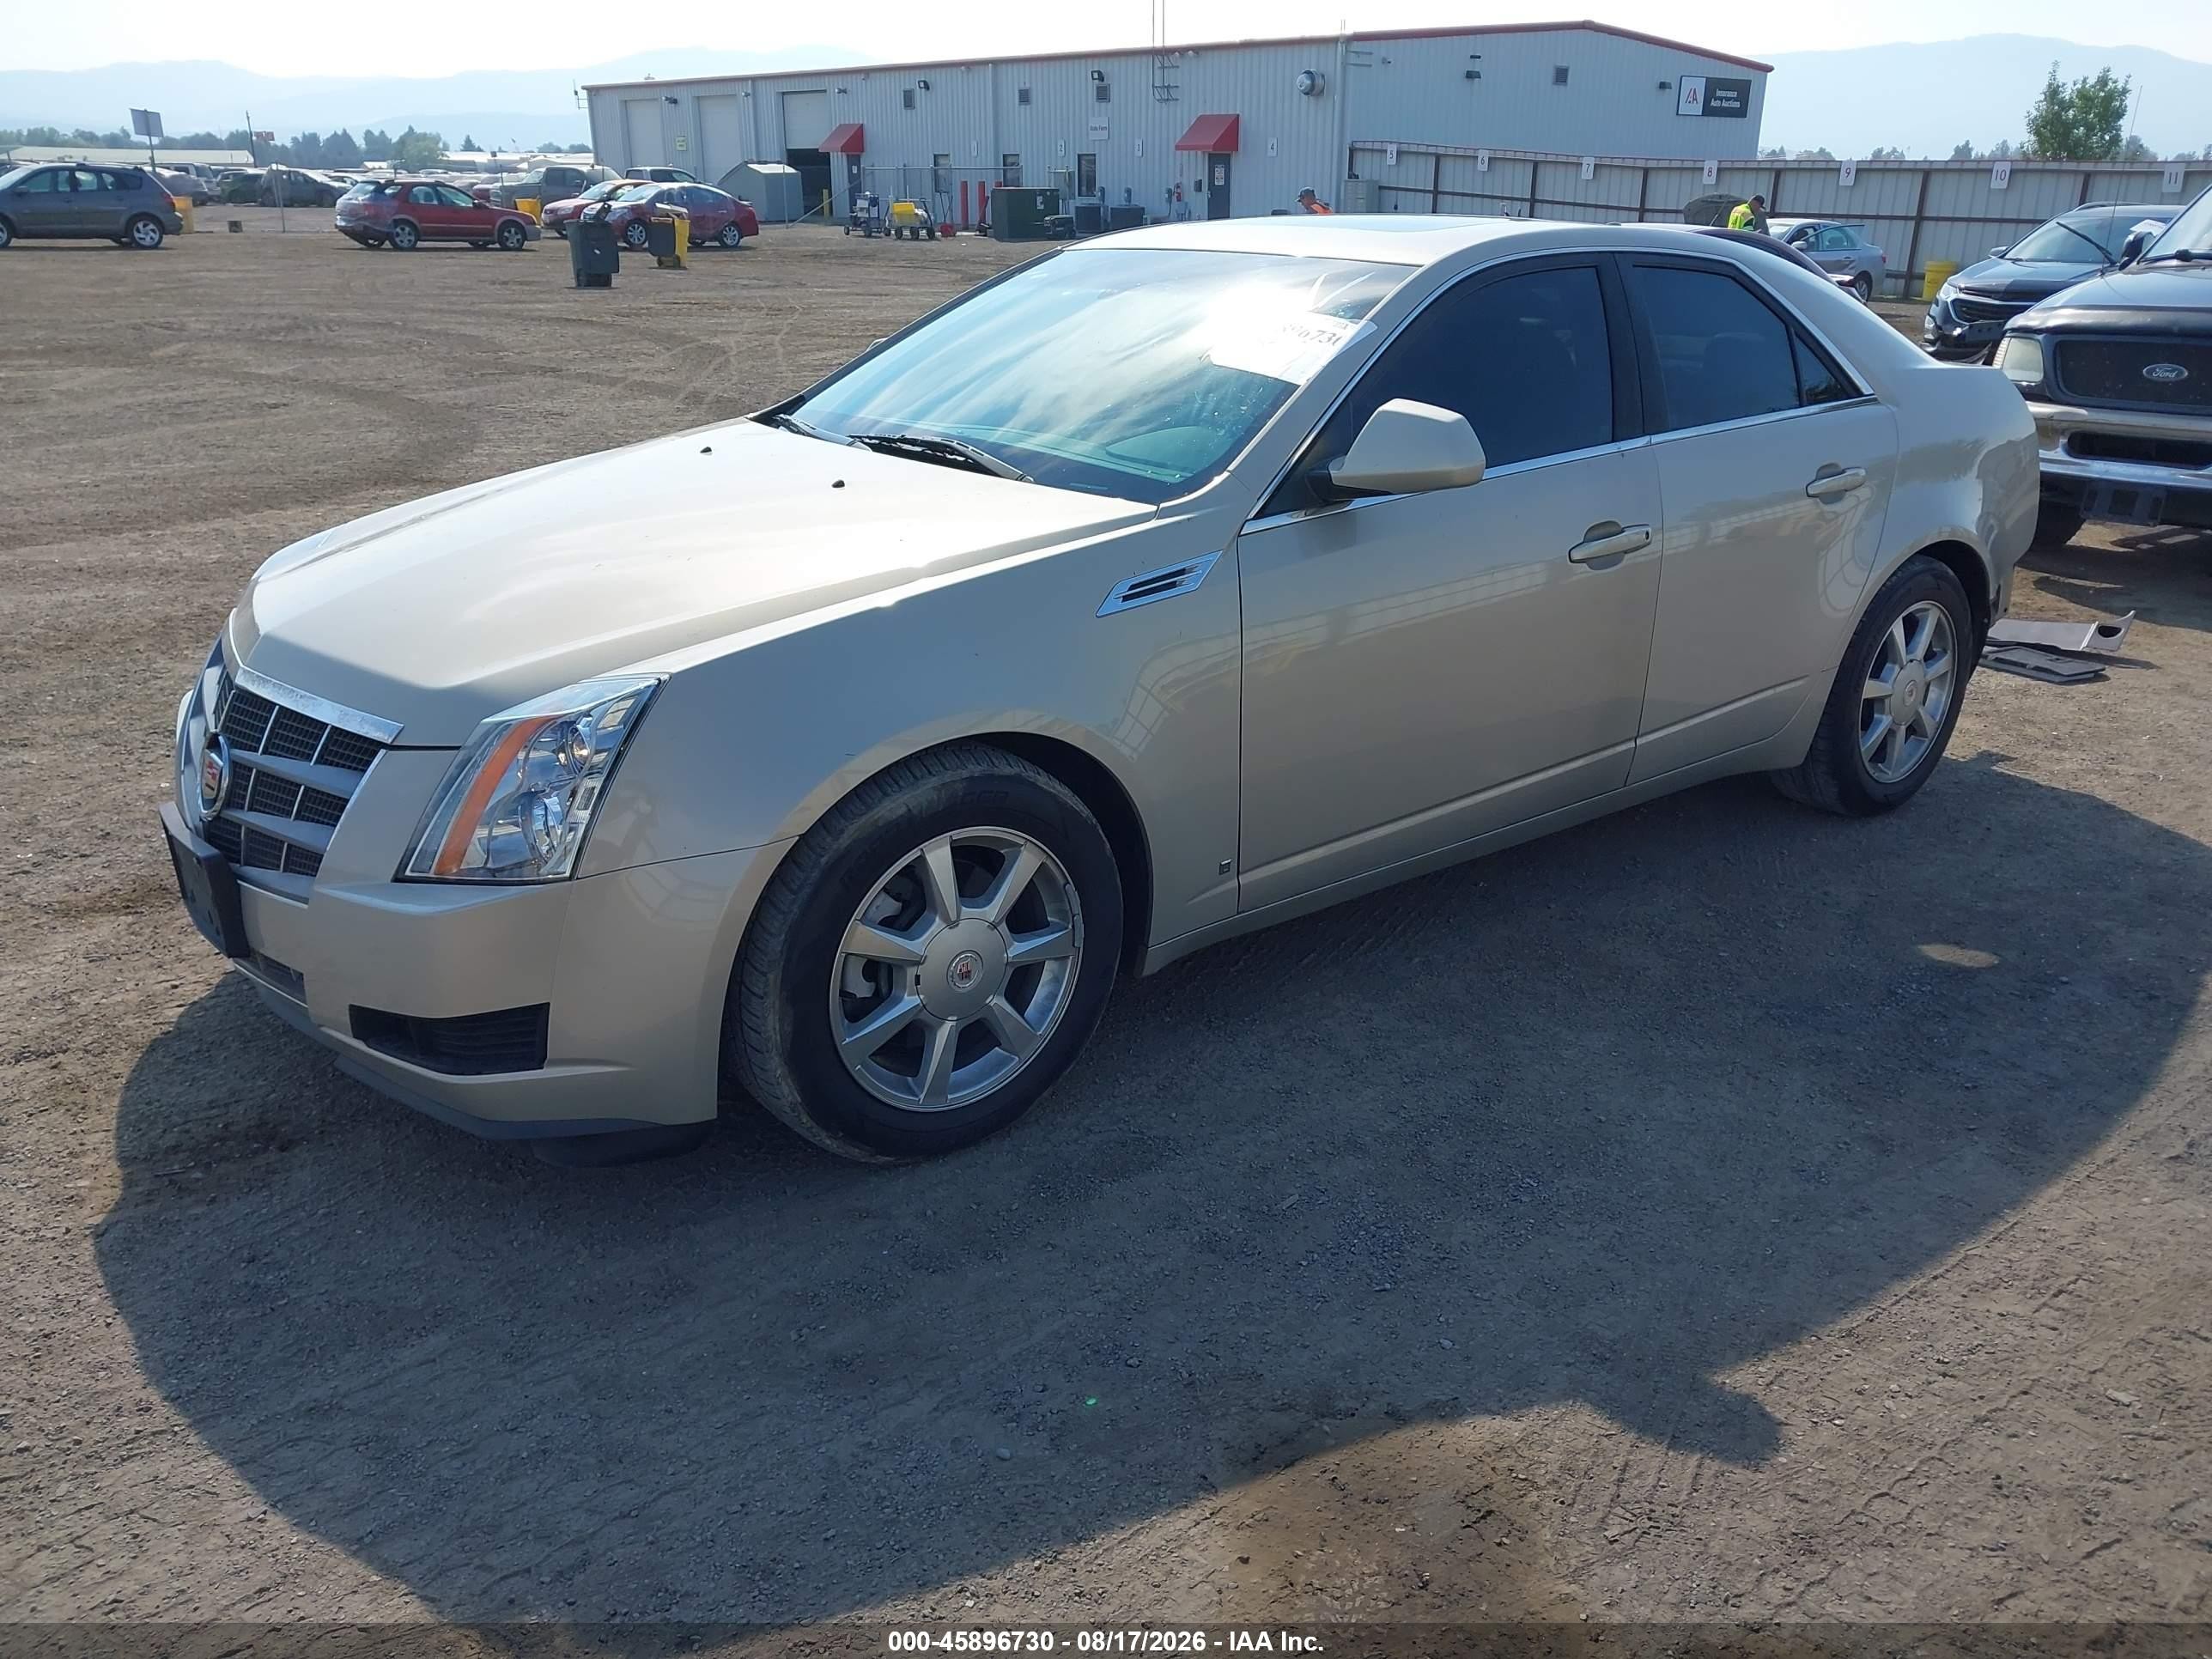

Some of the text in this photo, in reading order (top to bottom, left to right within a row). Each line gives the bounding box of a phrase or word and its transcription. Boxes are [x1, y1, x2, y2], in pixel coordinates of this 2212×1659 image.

[1270, 143, 1275, 151] 4
[1389, 149, 1394, 159] 5
[1480, 156, 1486, 166] 6
[1586, 163, 1590, 173] 7
[1707, 167, 1713, 177] 8
[1845, 167, 1851, 178] 9
[1995, 169, 2006, 181] 10
[2168, 172, 2179, 185] 11
[2152, 367, 2179, 379] Ford
